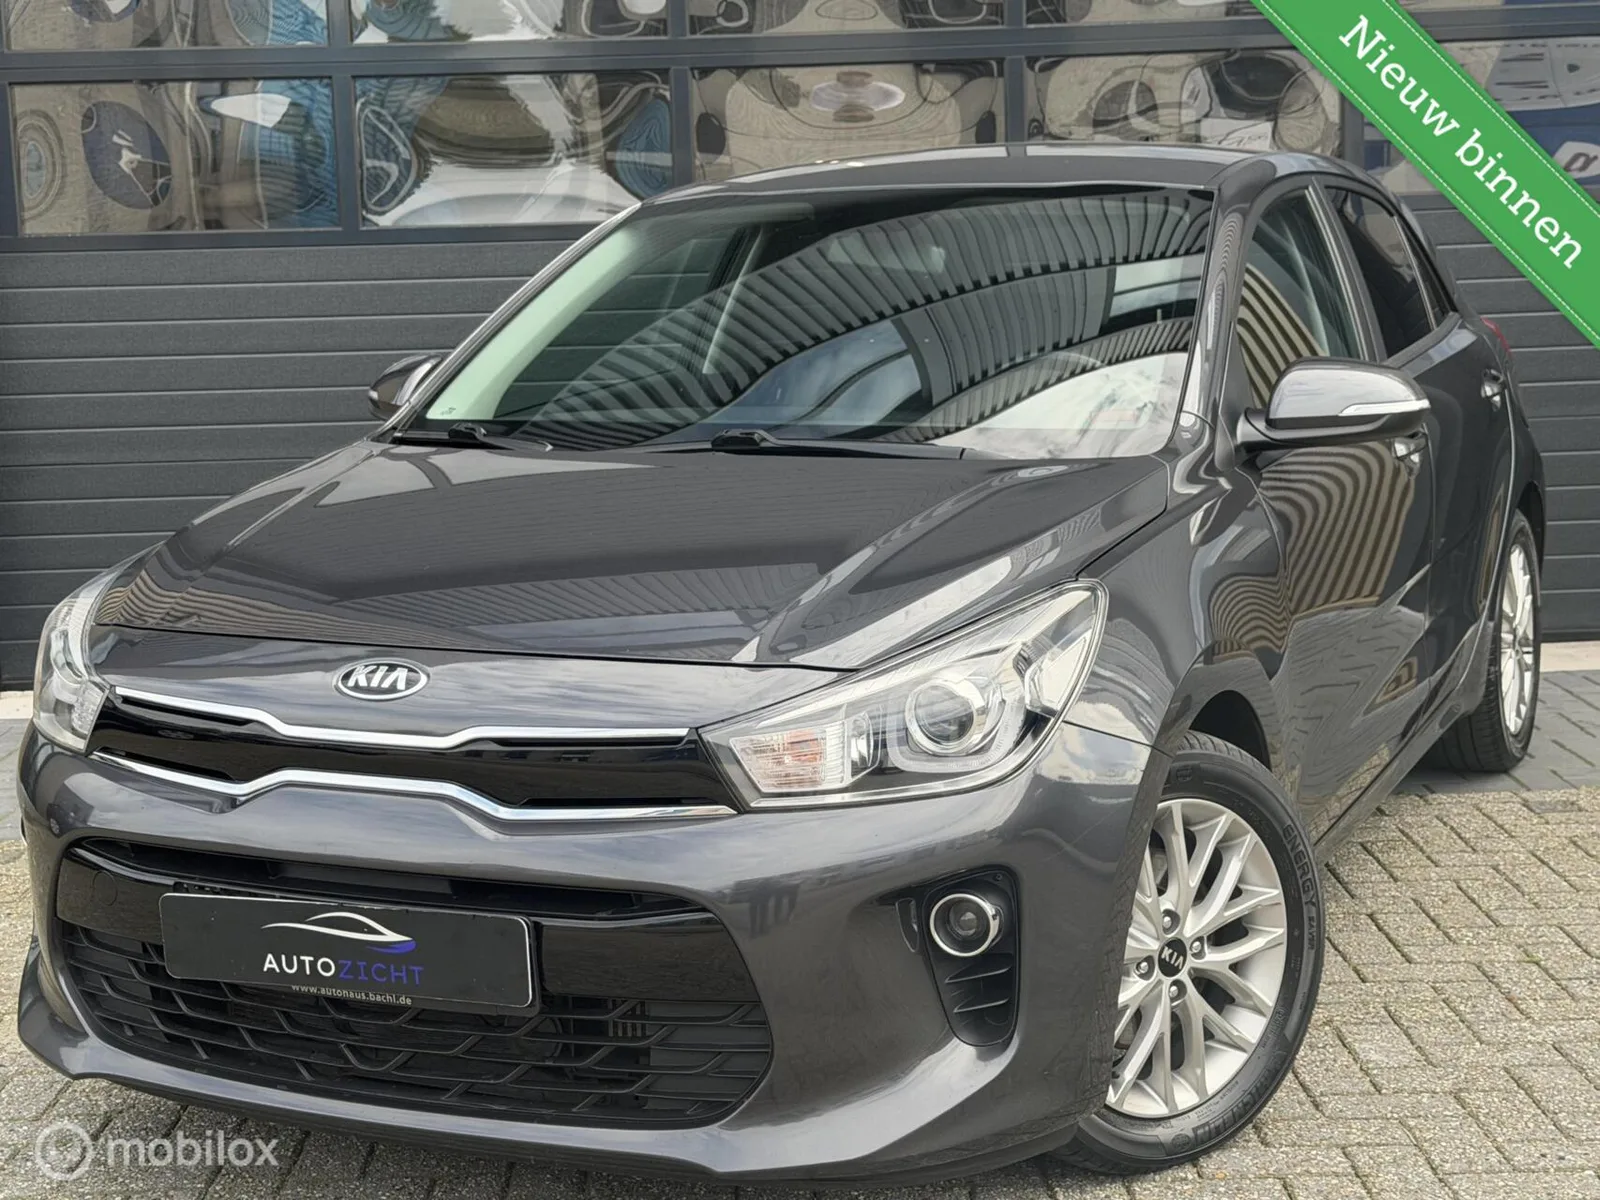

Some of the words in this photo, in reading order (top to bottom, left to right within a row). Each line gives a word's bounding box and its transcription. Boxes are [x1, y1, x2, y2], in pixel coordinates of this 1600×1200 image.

[346, 664, 409, 691] KIA
[1282, 823, 1317, 909] ENERGY
[262, 952, 425, 986] AUTOZICHT
[1160, 945, 1184, 971] KIA
